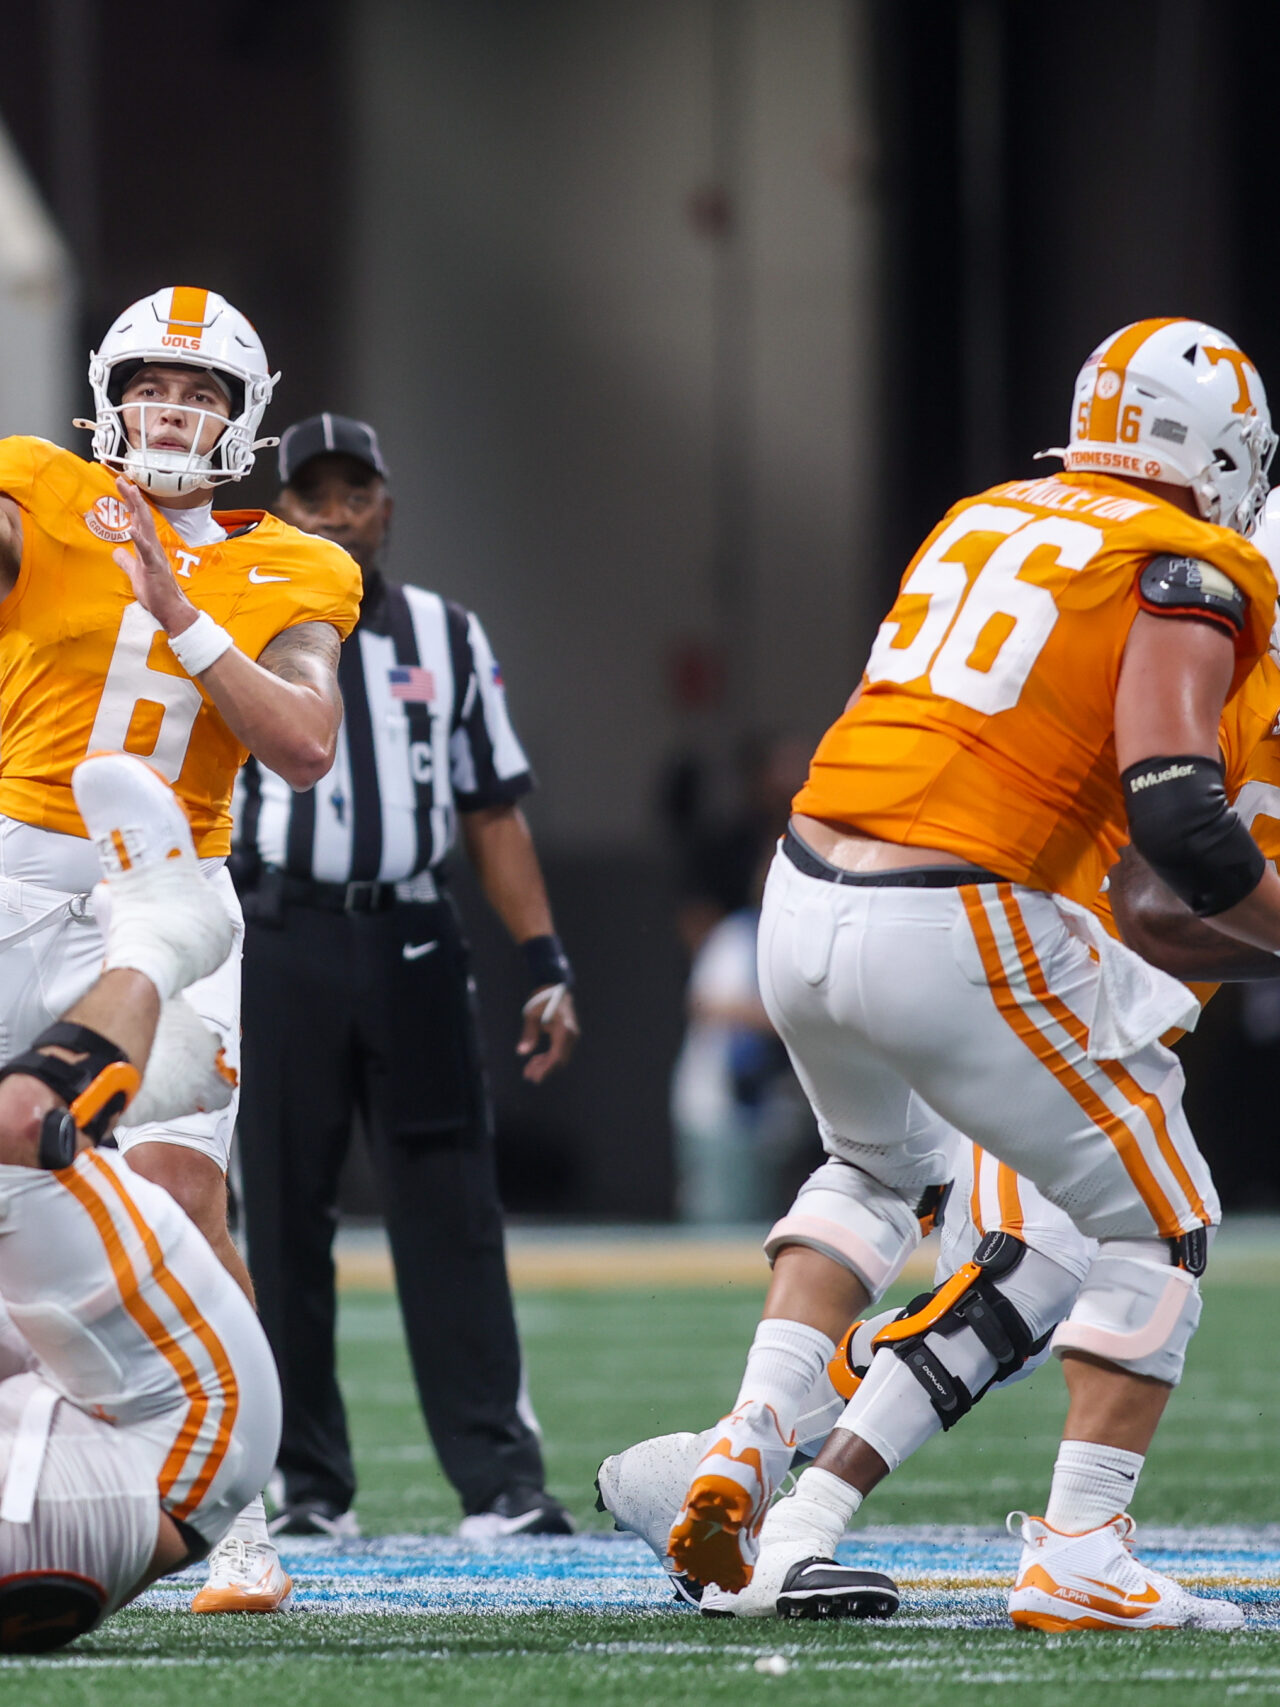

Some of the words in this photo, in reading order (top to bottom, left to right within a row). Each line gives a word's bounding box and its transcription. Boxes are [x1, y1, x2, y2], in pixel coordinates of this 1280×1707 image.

[161, 336, 201, 351] VOLS
[1202, 345, 1258, 417] T
[1071, 451, 1140, 472] TENNESSEE
[95, 496, 131, 528] SEC
[88, 520, 128, 541] GRADUAT
[175, 549, 201, 578] T
[866, 503, 1104, 716] 56
[86, 600, 203, 785] 6
[410, 741, 432, 783] C
[922, 1365, 947, 1395] DONJOY
[1035, 1535, 1048, 1548] T
[1054, 1588, 1091, 1604] ALPHA
